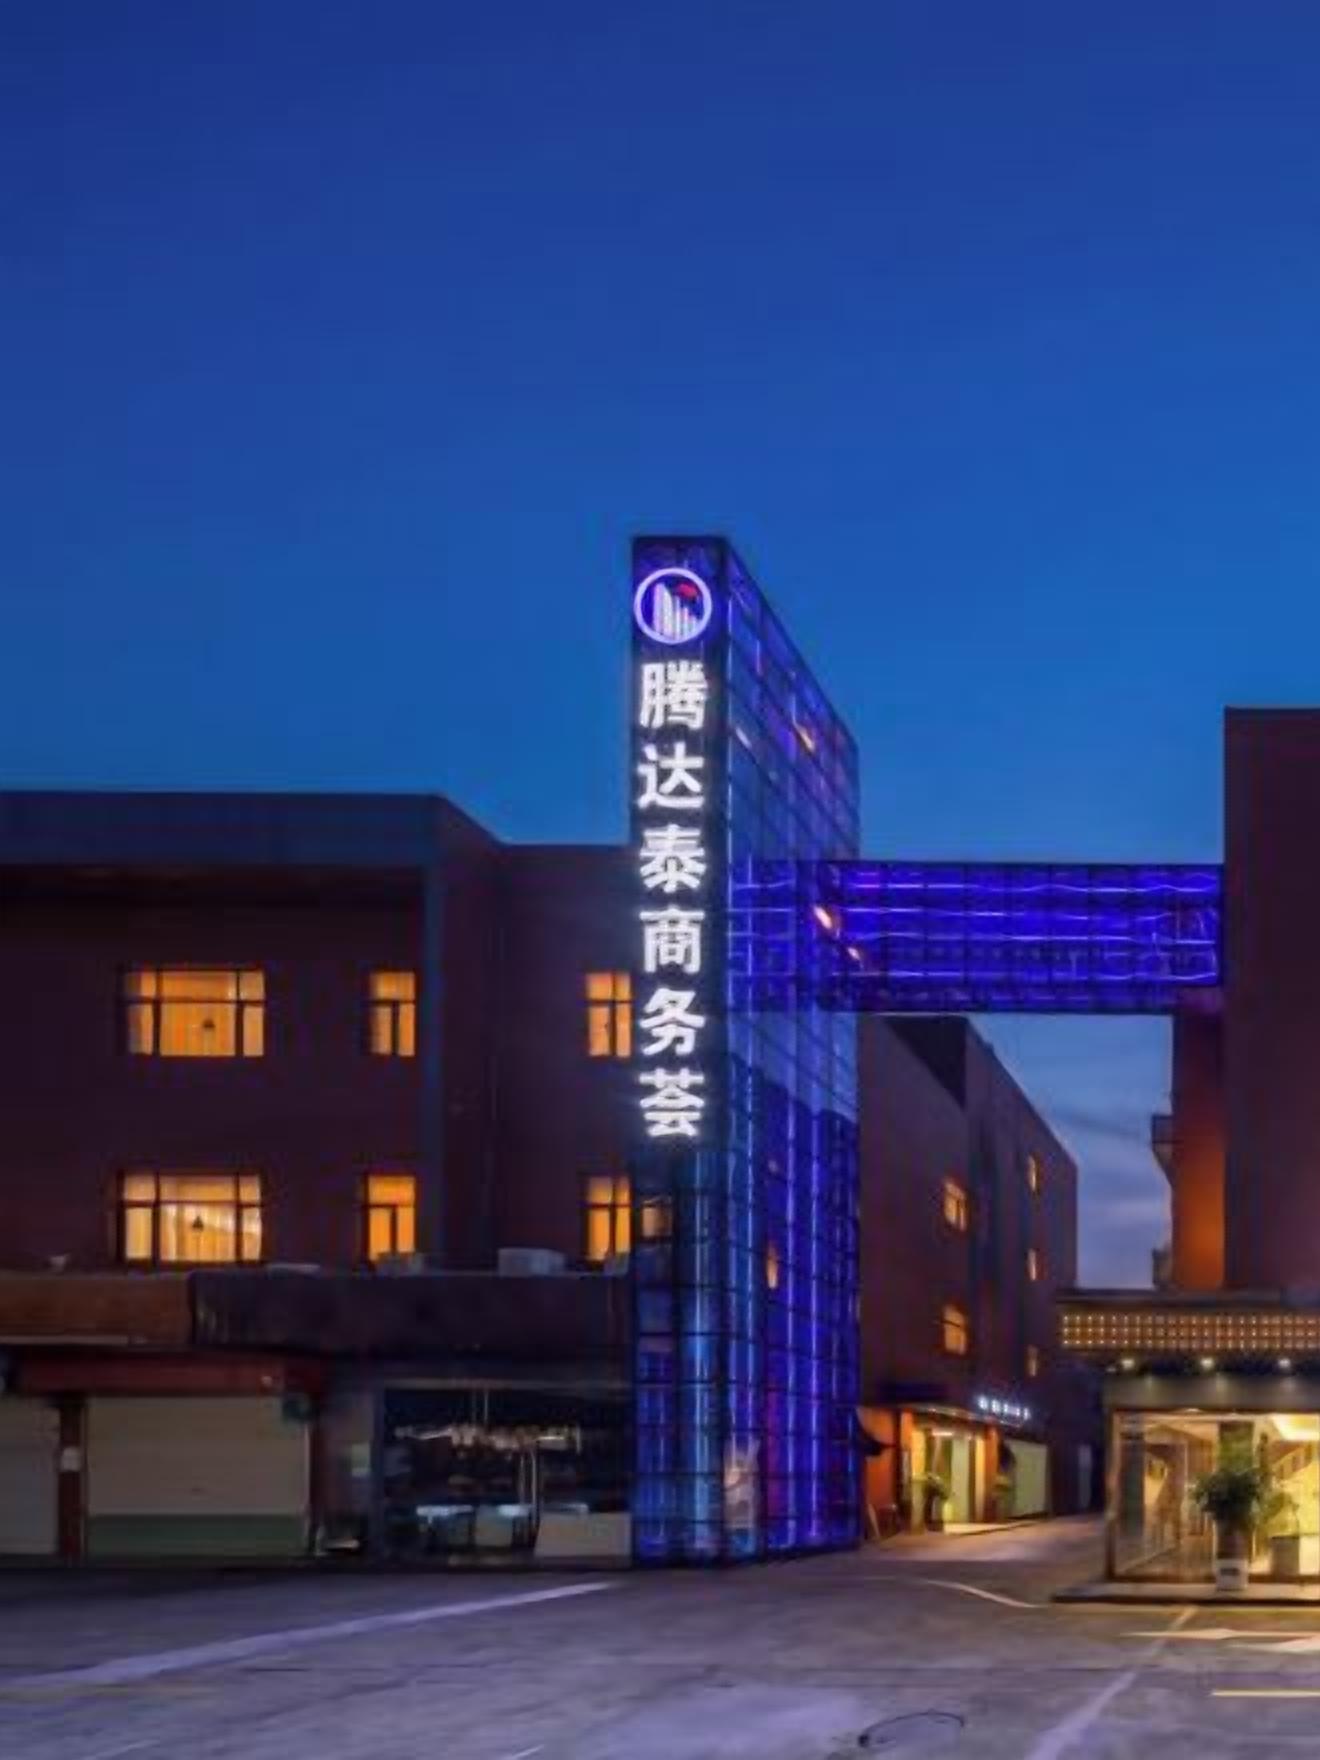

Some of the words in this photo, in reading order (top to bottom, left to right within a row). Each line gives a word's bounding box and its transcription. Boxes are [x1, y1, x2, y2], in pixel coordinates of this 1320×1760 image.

[637, 660, 708, 1138] 腾达泰商务荟
